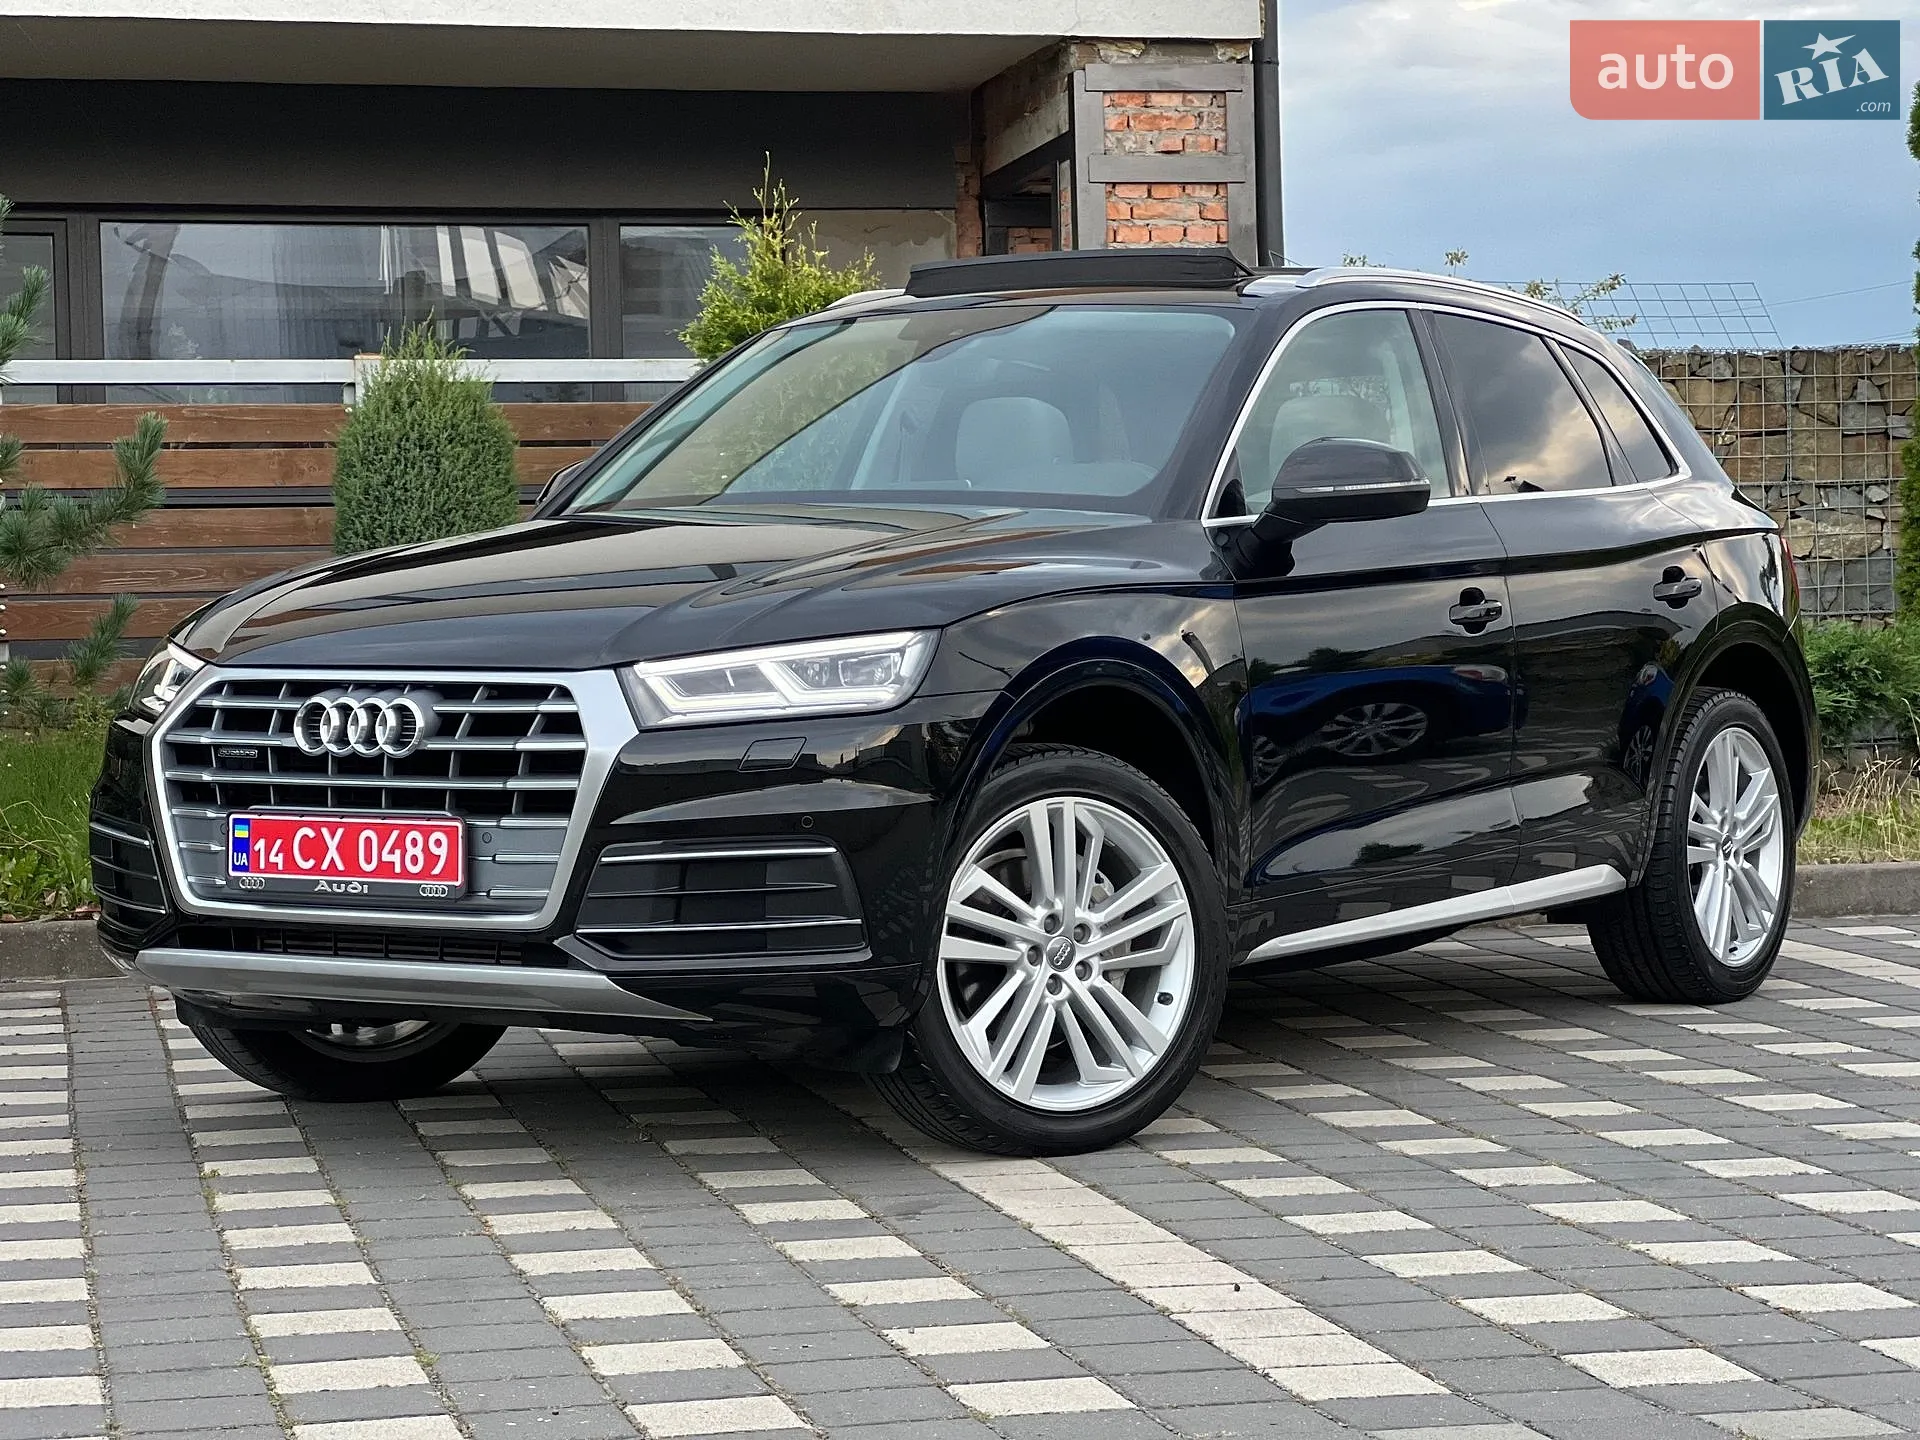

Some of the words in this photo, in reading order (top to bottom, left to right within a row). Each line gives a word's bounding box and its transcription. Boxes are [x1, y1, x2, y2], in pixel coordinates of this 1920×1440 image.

[253, 838, 285, 871] 14
[292, 826, 345, 872] CX
[358, 829, 449, 875] 0489
[233, 851, 249, 866] UA
[314, 880, 369, 894] Audi
